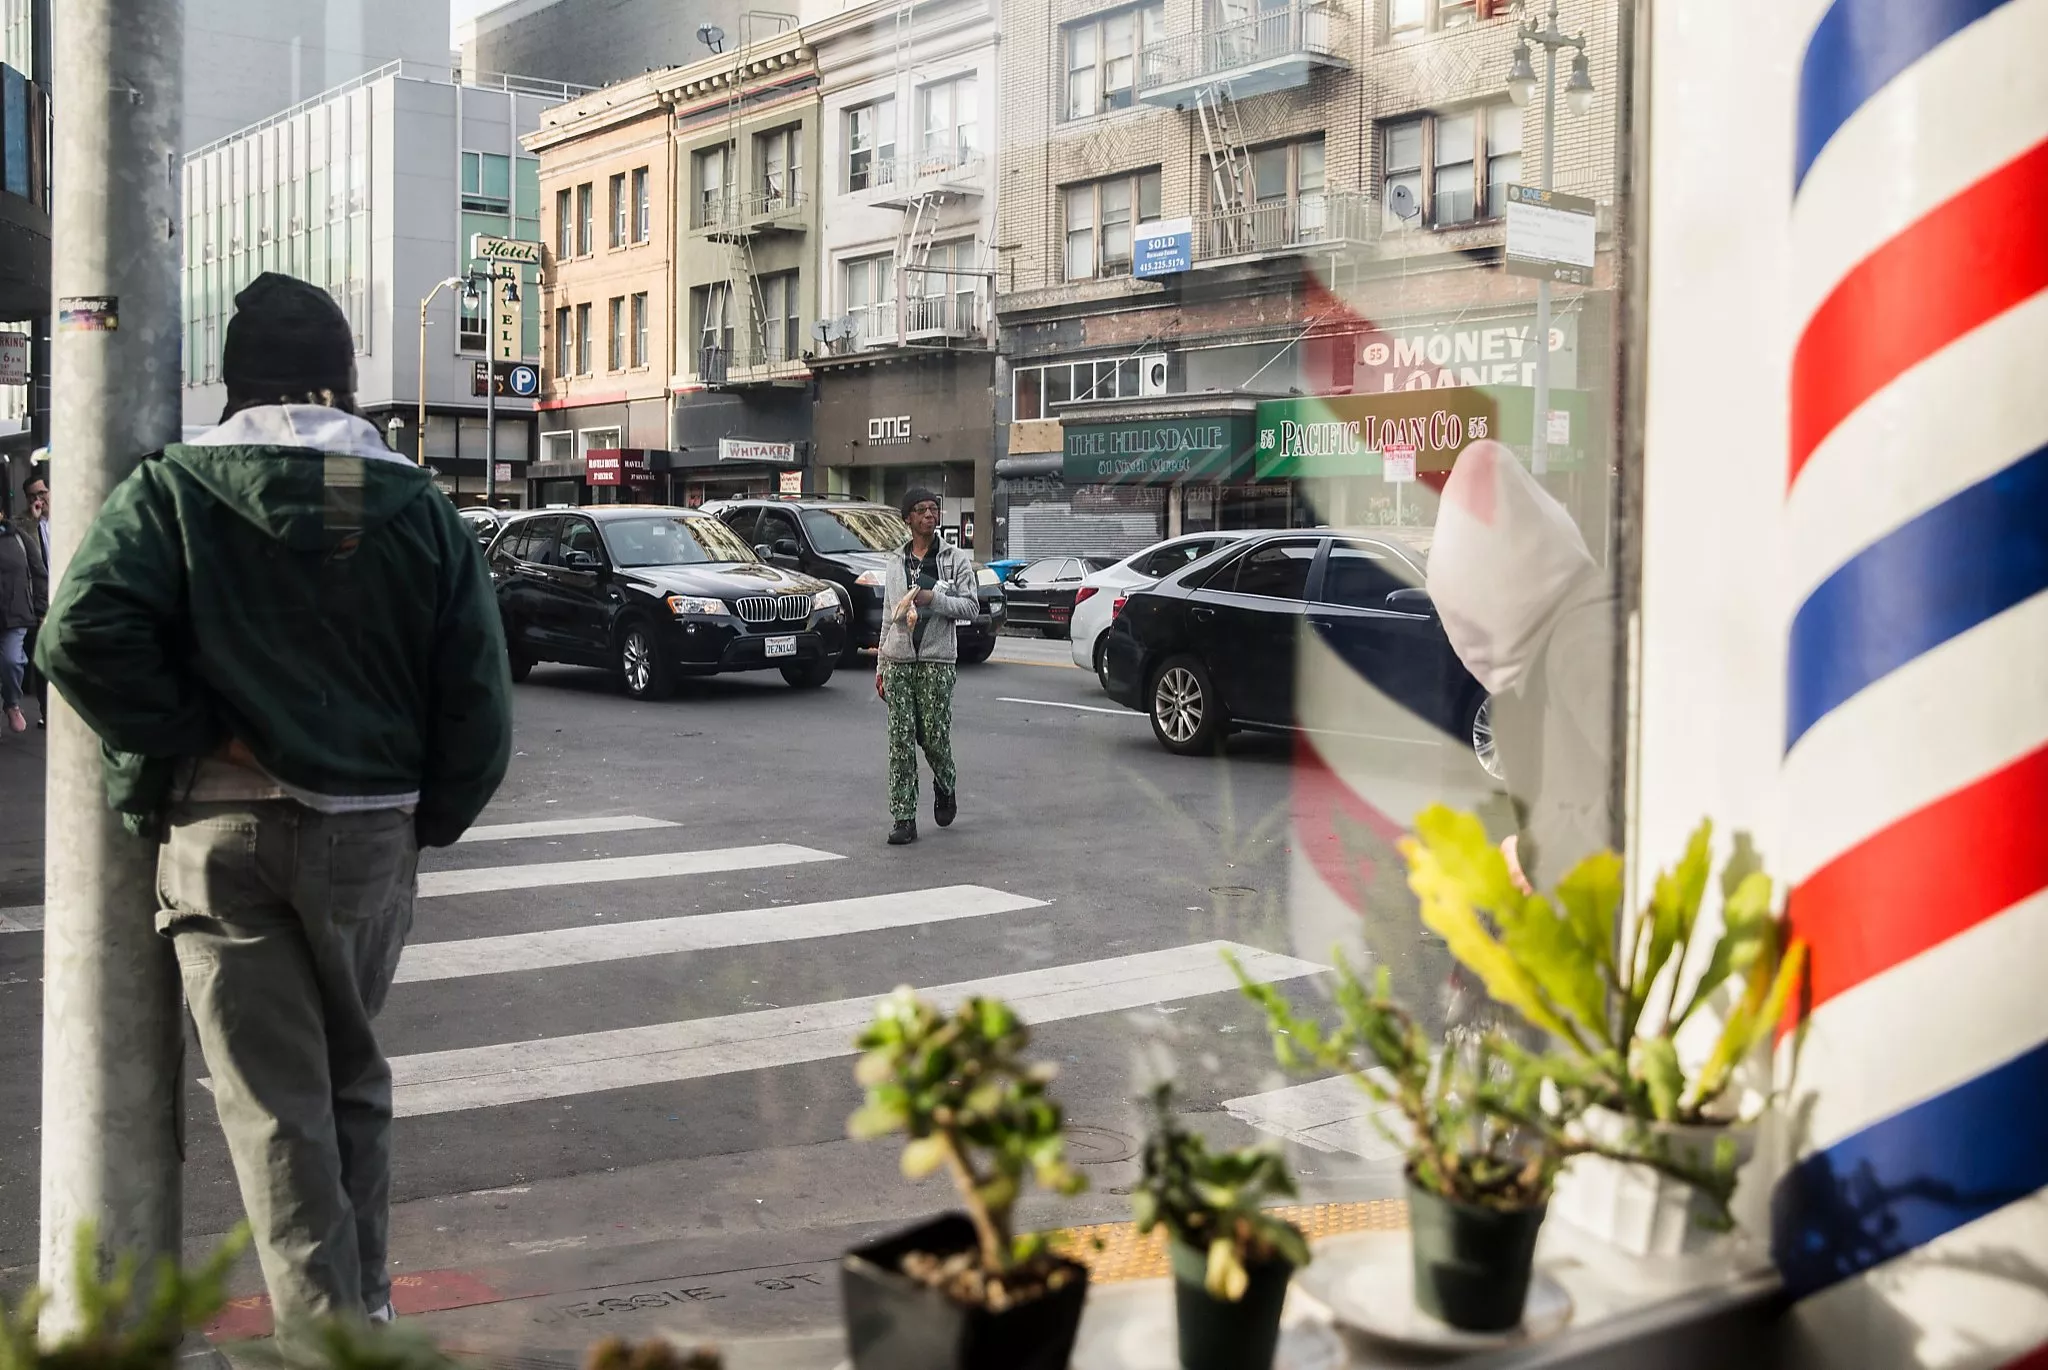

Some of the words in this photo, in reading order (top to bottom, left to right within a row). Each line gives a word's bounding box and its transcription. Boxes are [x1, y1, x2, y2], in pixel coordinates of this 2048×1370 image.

[483, 240, 537, 260] Hotel
[1148, 237, 1175, 250] SOLD
[1368, 347, 1383, 361] 55
[1393, 326, 1530, 368] MONEY
[869, 415, 911, 439] OMG
[1260, 429, 1275, 449] 55
[1280, 420, 1359, 457] PACIFIC
[1365, 415, 1427, 454] LOAN
[1429, 410, 1462, 450] CO
[1467, 416, 1488, 439] 55
[729, 445, 791, 456] WHITAKER
[1069, 432, 1106, 456] THE
[1110, 426, 1222, 454] HILLSDALE
[1150, 457, 1190, 474] Street
